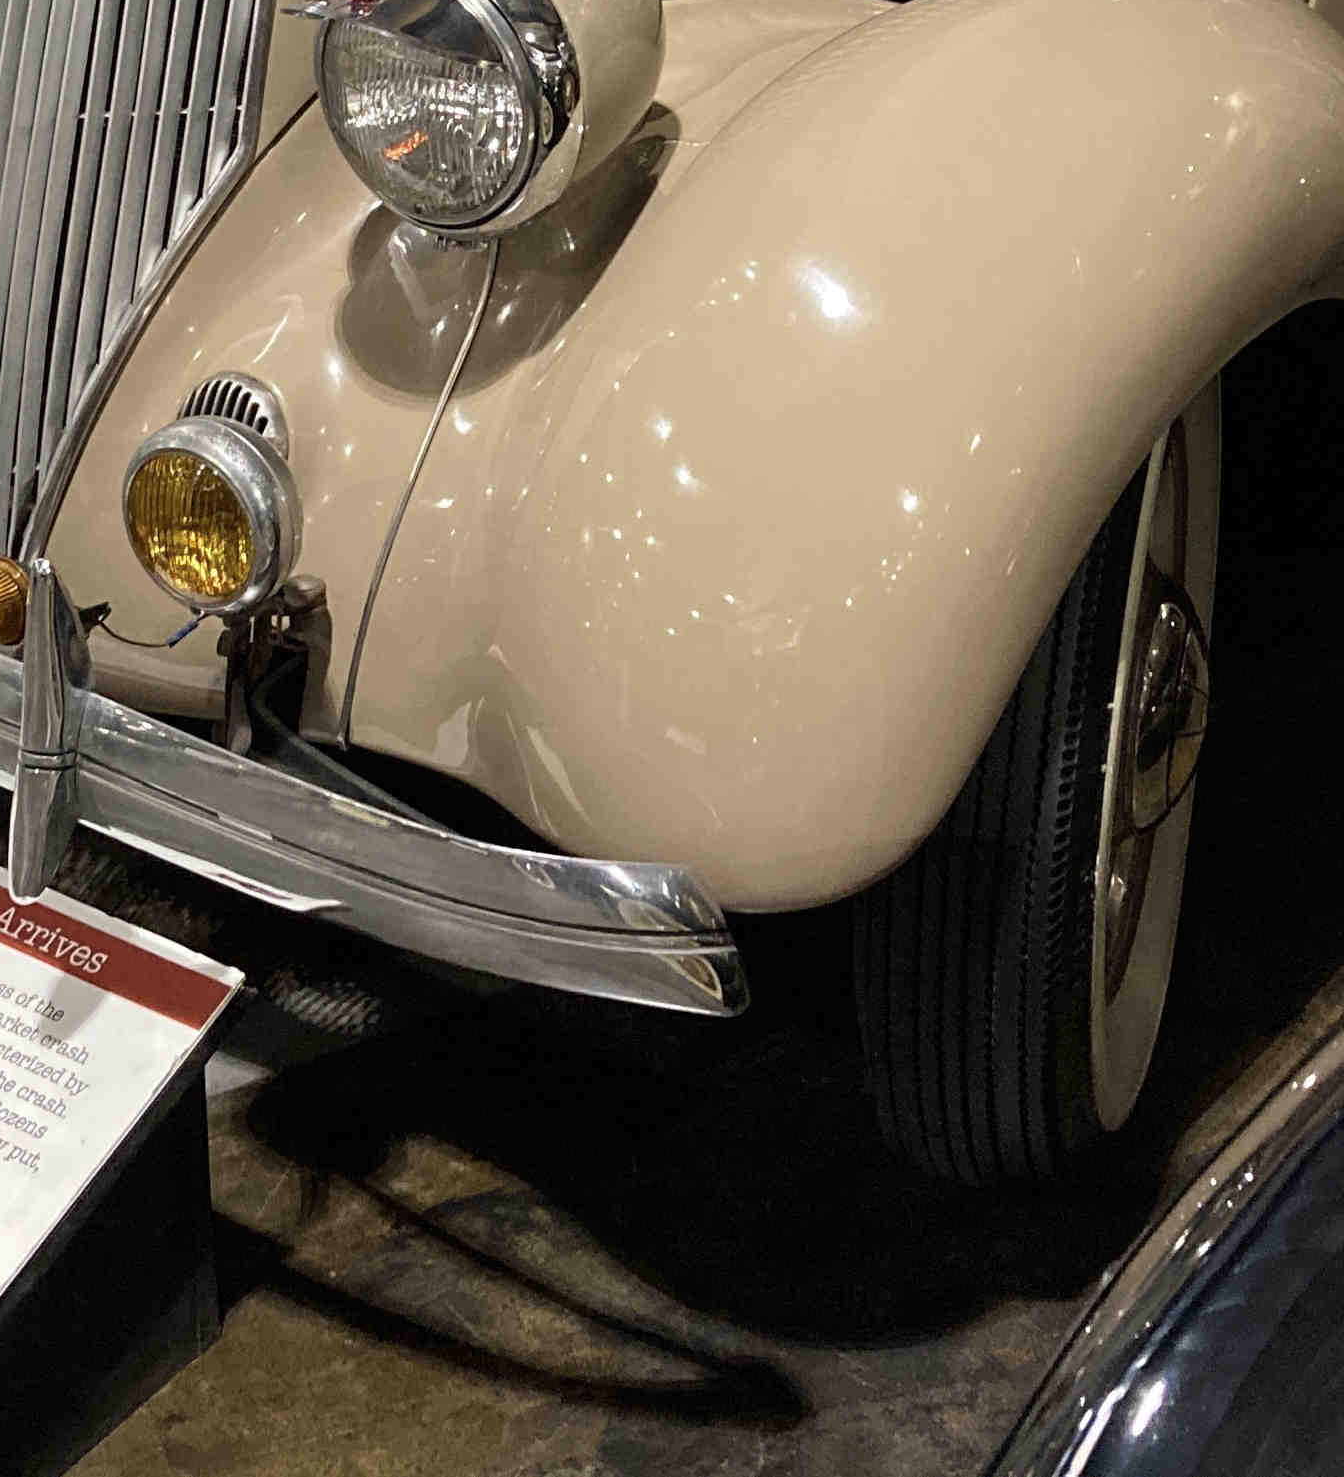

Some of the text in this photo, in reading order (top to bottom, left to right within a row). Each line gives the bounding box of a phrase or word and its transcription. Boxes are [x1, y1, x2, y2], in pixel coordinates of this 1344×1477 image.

[13, 991, 40, 1010] of
[32, 997, 66, 1024] the
[38, 1027, 90, 1067] crash
[62, 1071, 92, 1098] by
[15, 1085, 68, 1121] crash.
[1, 1144, 42, 1175] put,
